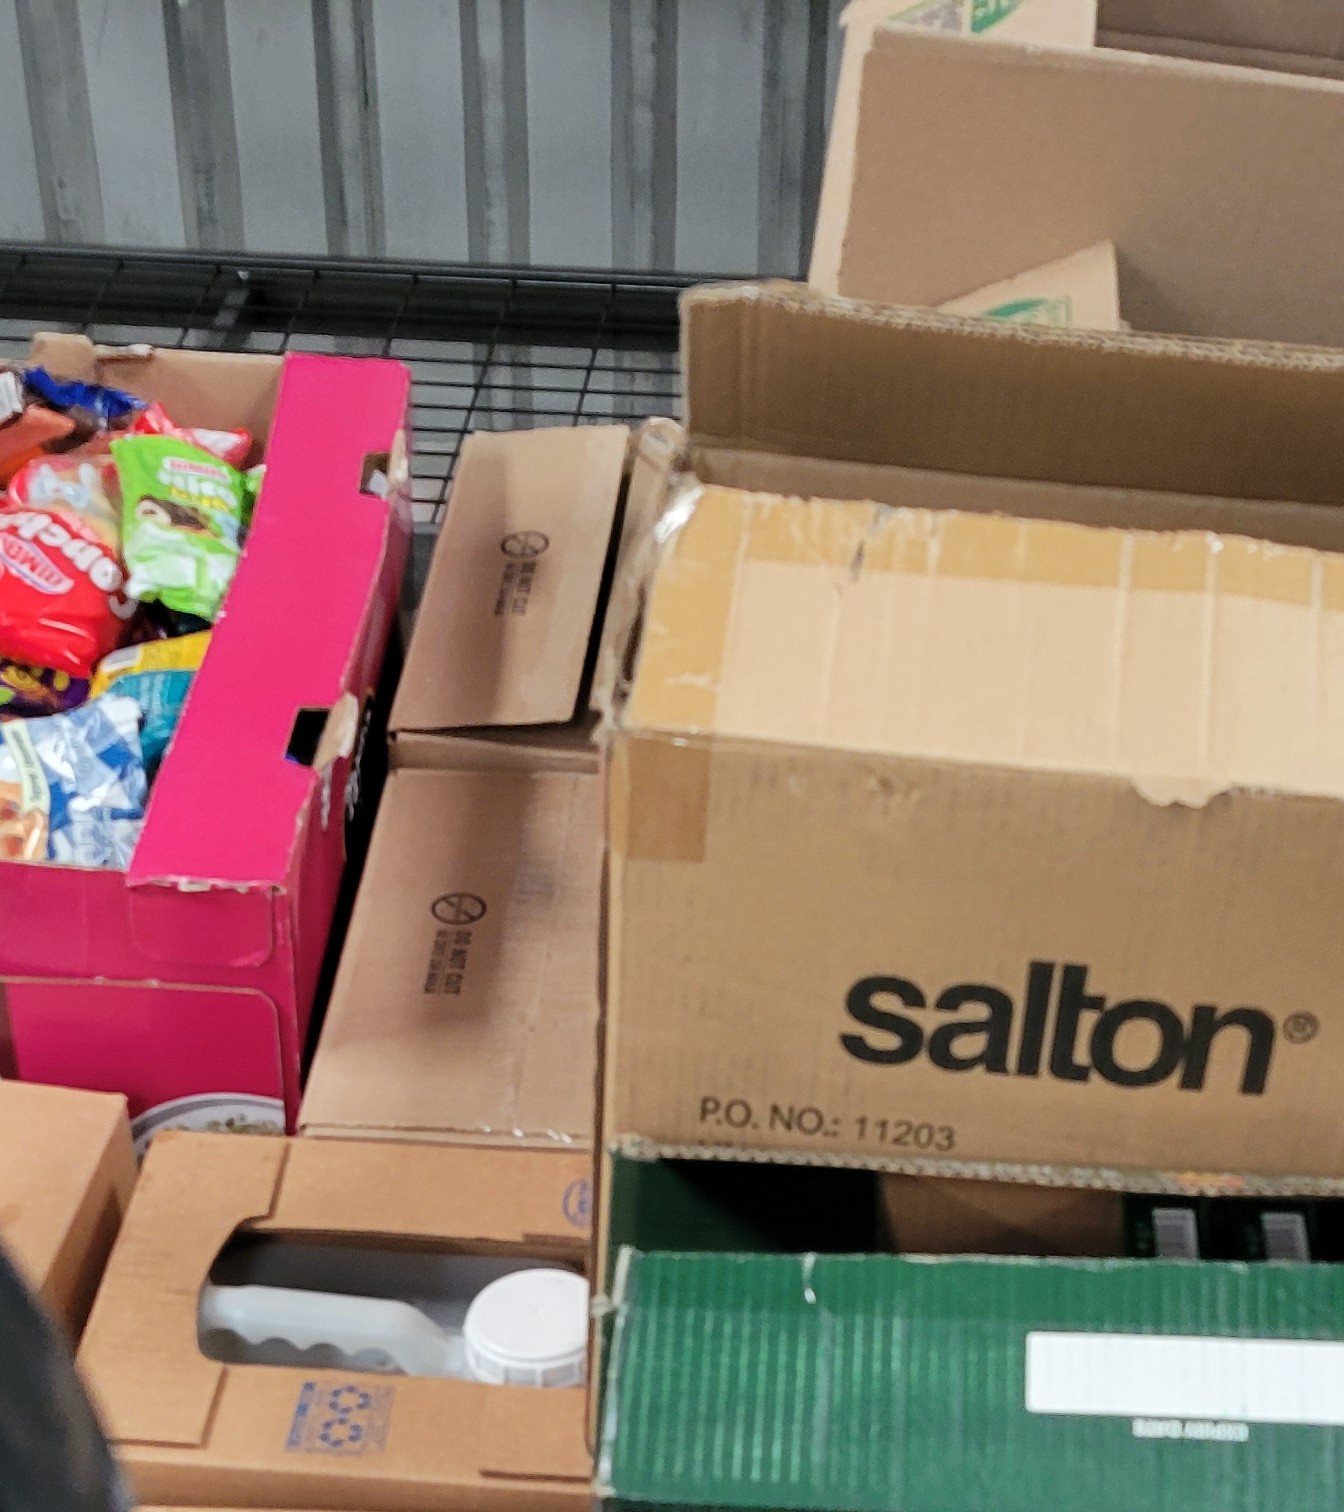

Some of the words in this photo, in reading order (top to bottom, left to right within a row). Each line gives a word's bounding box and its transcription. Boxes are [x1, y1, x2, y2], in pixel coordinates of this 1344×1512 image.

[839, 959, 1277, 1096] salton
[698, 1095, 757, 1130] P.O.
[770, 1102, 839, 1138] NO.:
[856, 1115, 956, 1153] 11203
